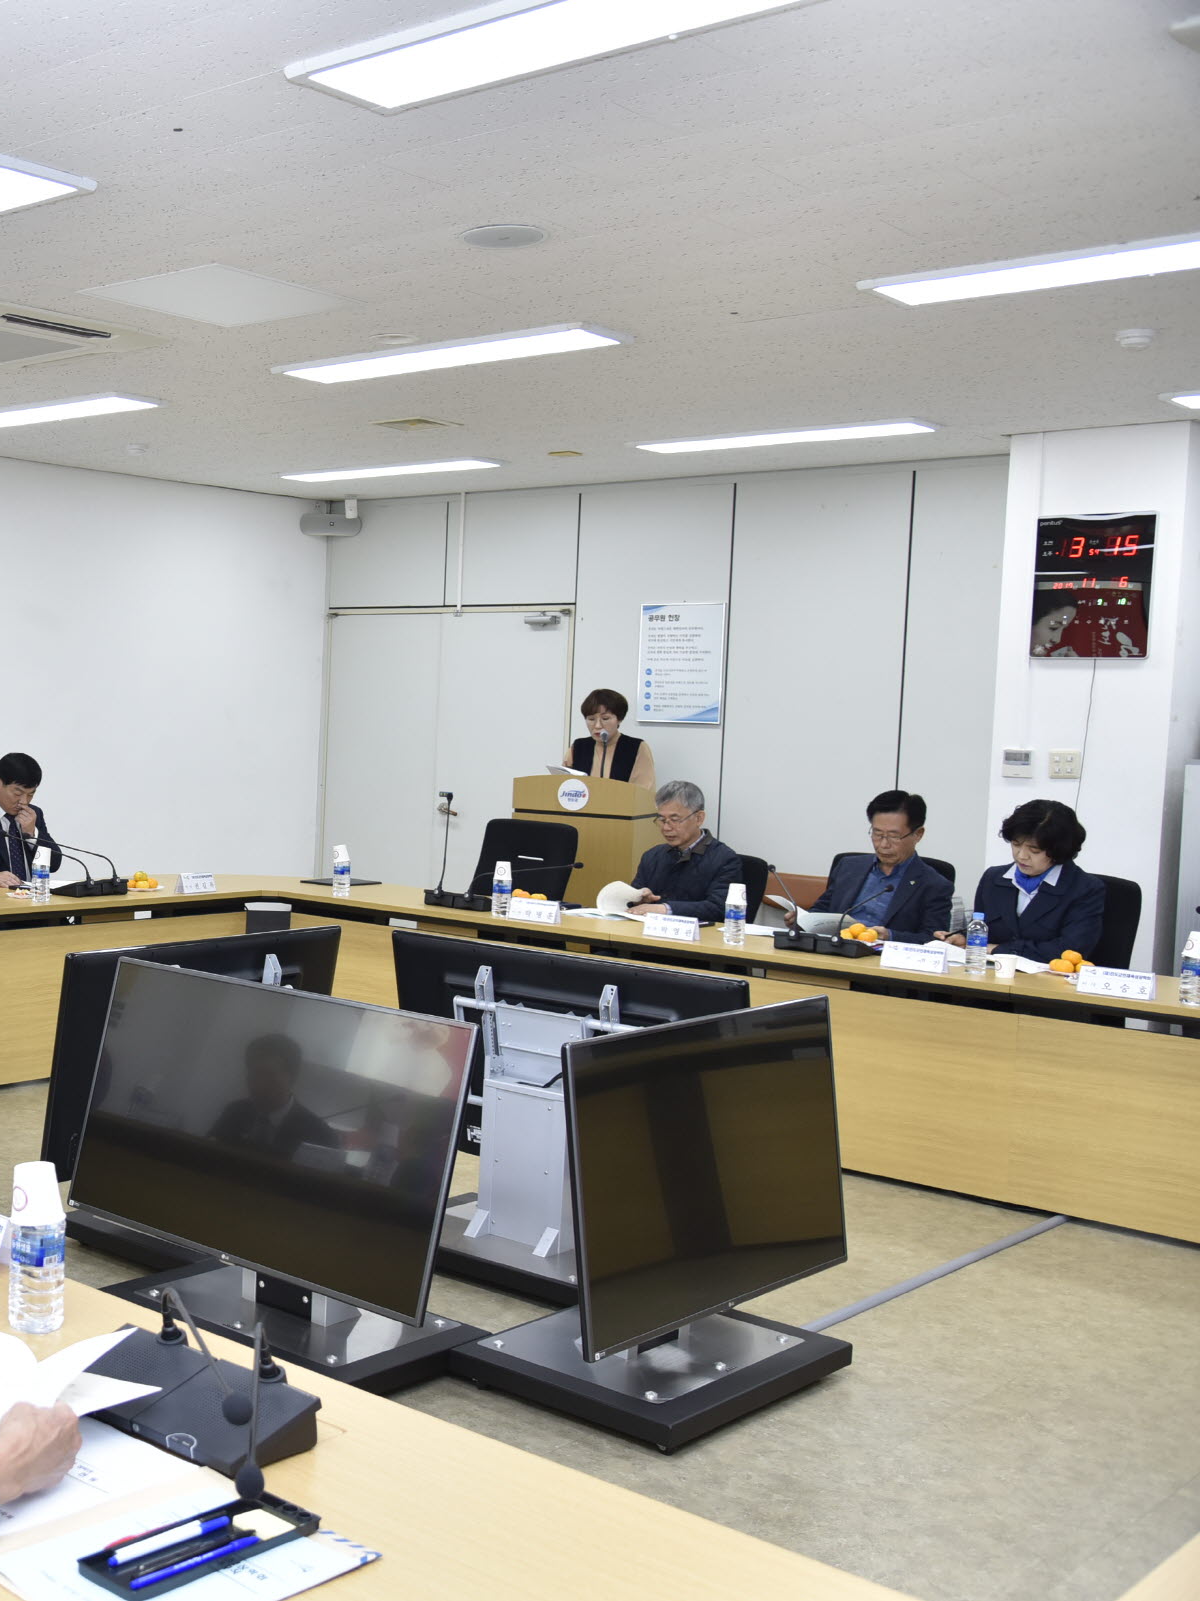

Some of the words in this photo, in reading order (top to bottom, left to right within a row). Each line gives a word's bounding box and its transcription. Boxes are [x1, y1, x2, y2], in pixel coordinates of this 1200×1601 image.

[1068, 536, 1086, 558] 3
[1113, 534, 1140, 556] 15
[1118, 576, 1129, 588] 6
